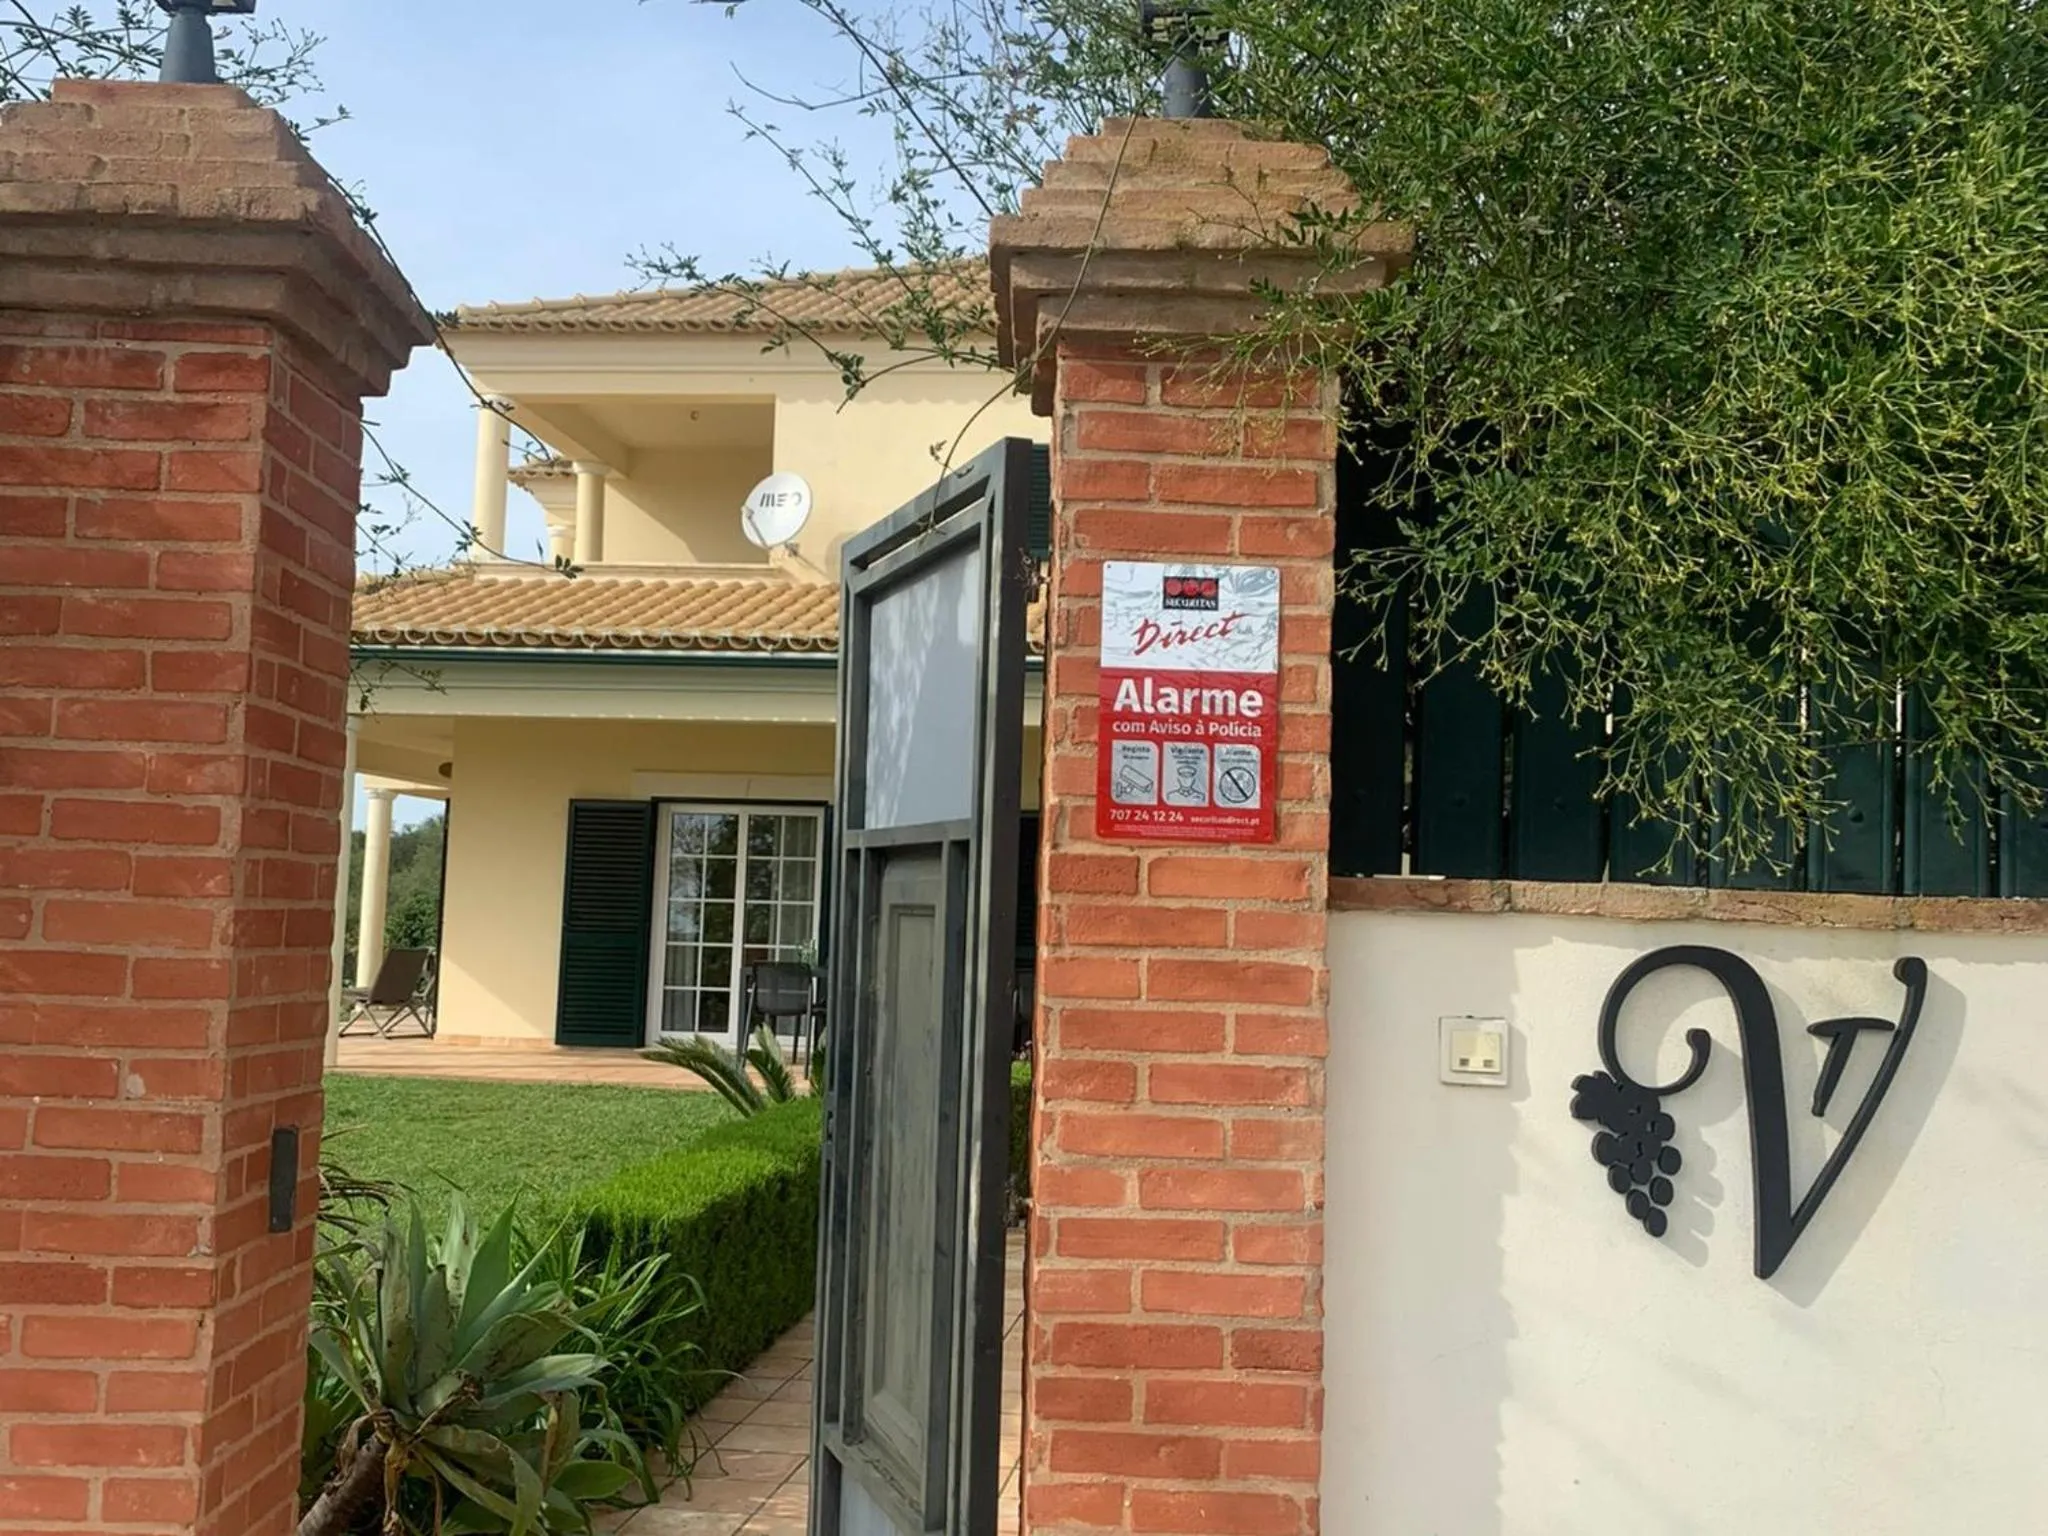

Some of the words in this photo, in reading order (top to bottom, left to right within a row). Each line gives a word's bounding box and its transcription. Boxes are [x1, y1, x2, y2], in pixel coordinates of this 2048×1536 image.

[1131, 611, 1250, 656] Direct
[1113, 677, 1264, 718] Alarme
[1112, 720, 1145, 733] com
[1150, 718, 1191, 735] Aviso
[1195, 720, 1205, 735] à
[1209, 720, 1262, 737] Polícia
[1110, 808, 1131, 821] 707
[1134, 809, 1150, 821] 24
[1152, 810, 1166, 822] 12
[1168, 810, 1185, 823] 24
